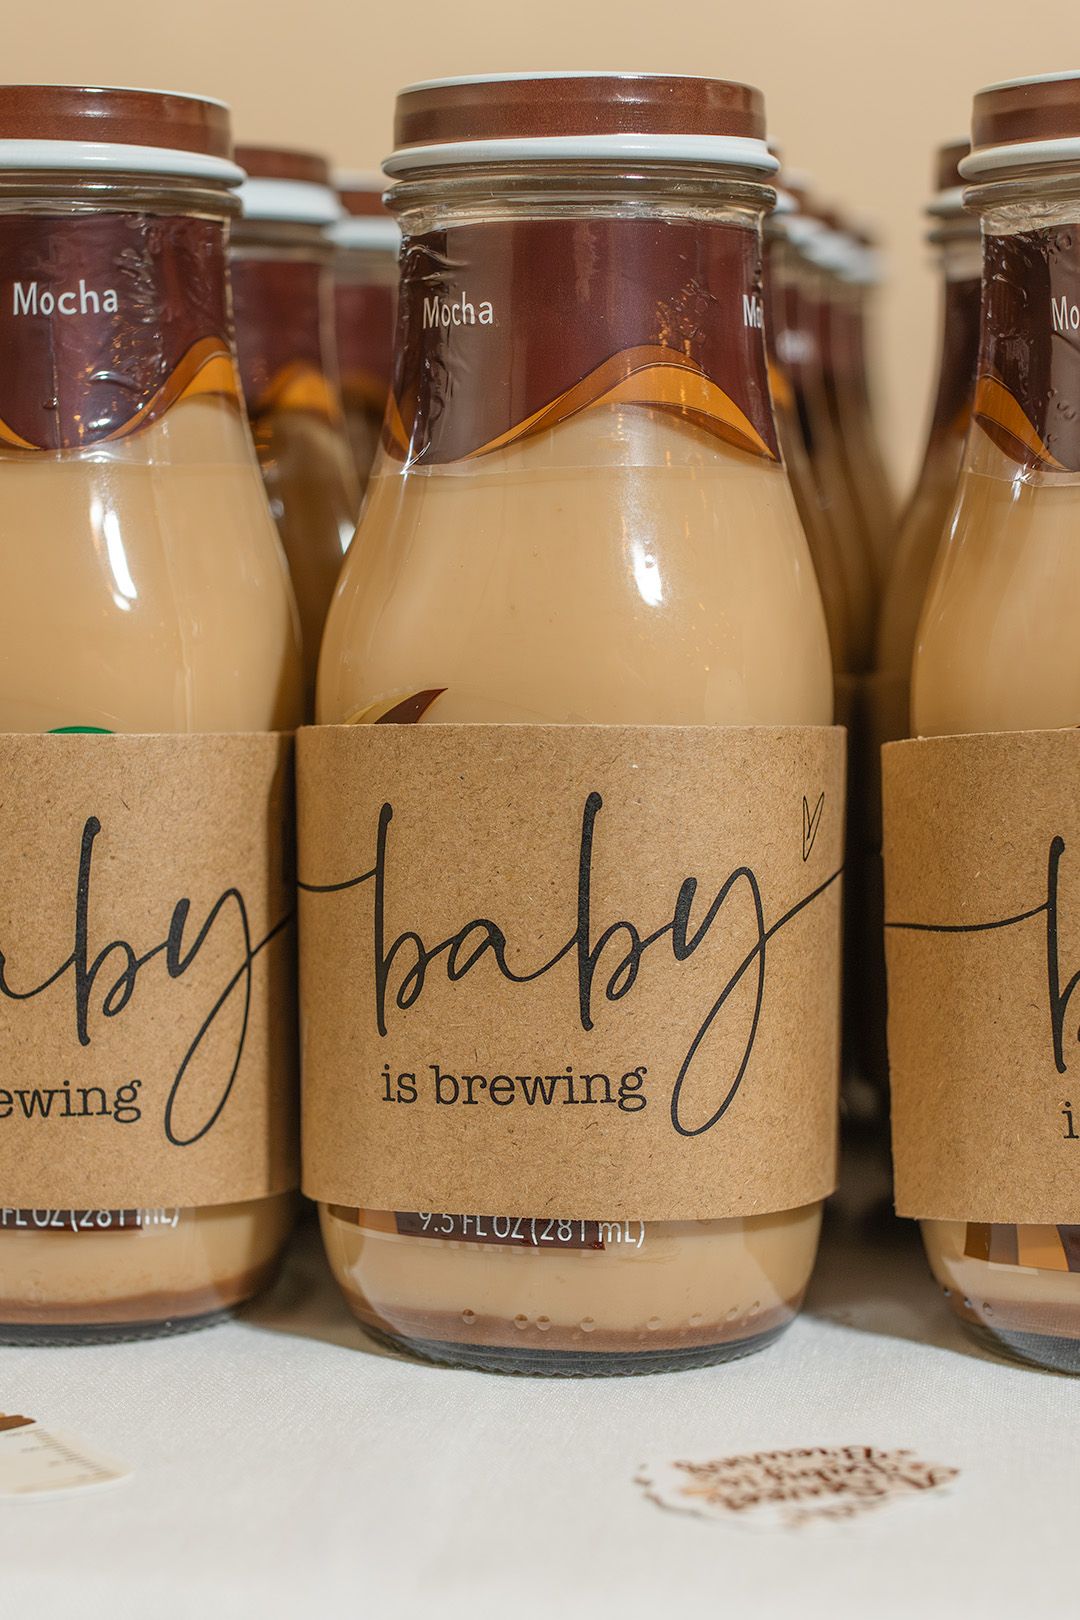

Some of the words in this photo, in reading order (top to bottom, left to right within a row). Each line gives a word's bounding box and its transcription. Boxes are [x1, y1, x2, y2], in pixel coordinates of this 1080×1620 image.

[13, 279, 119, 315] Mocha
[422, 291, 494, 329] Mocha
[0, 816, 296, 1146] by
[298, 791, 844, 1136] baby
[381, 1064, 418, 1104] is
[429, 1065, 648, 1112] brewing
[418, 1211, 455, 1233] 9.5
[462, 1214, 488, 1237] FL
